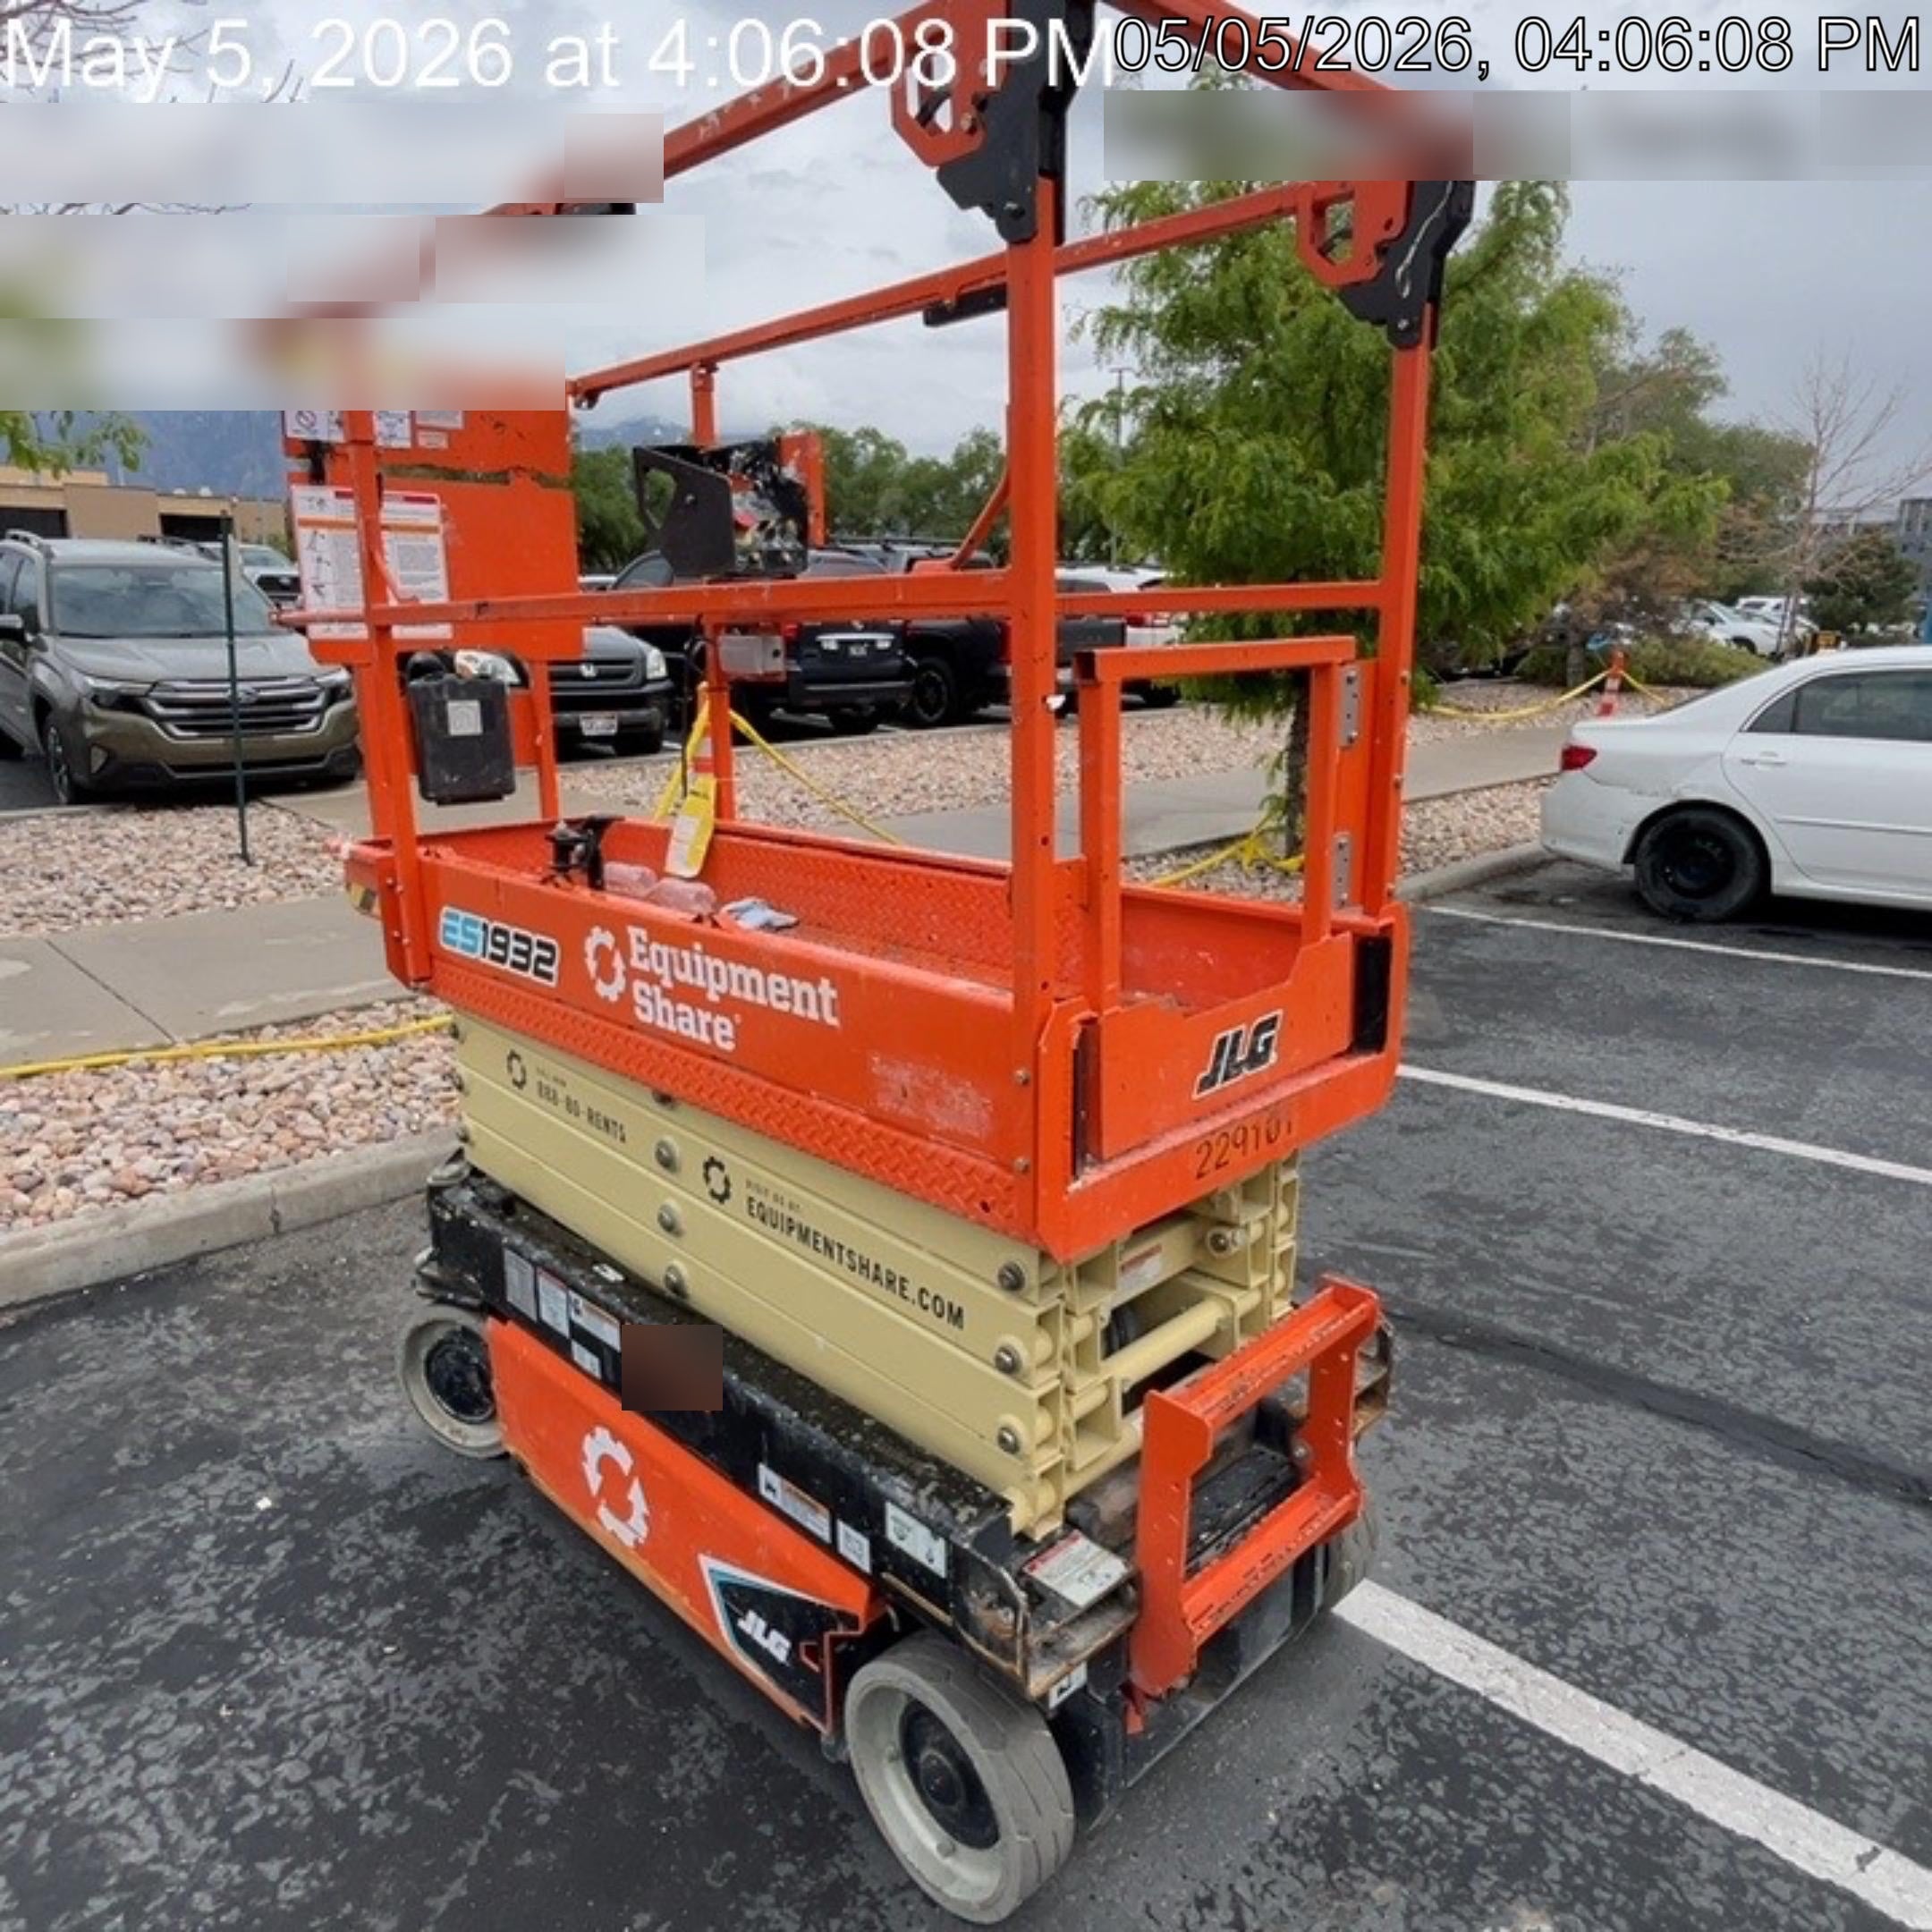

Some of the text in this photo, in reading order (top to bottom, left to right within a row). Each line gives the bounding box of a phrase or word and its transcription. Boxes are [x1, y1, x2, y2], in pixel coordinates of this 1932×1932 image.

[442, 908, 557, 984] ES1932
[627, 927, 841, 1028] Equipment
[632, 980, 736, 1052] Share
[1194, 1011, 1281, 1098] JLG
[748, 1195, 964, 1330] EQUIPMENTSHARE.COM
[737, 1610, 791, 1665] JLG
